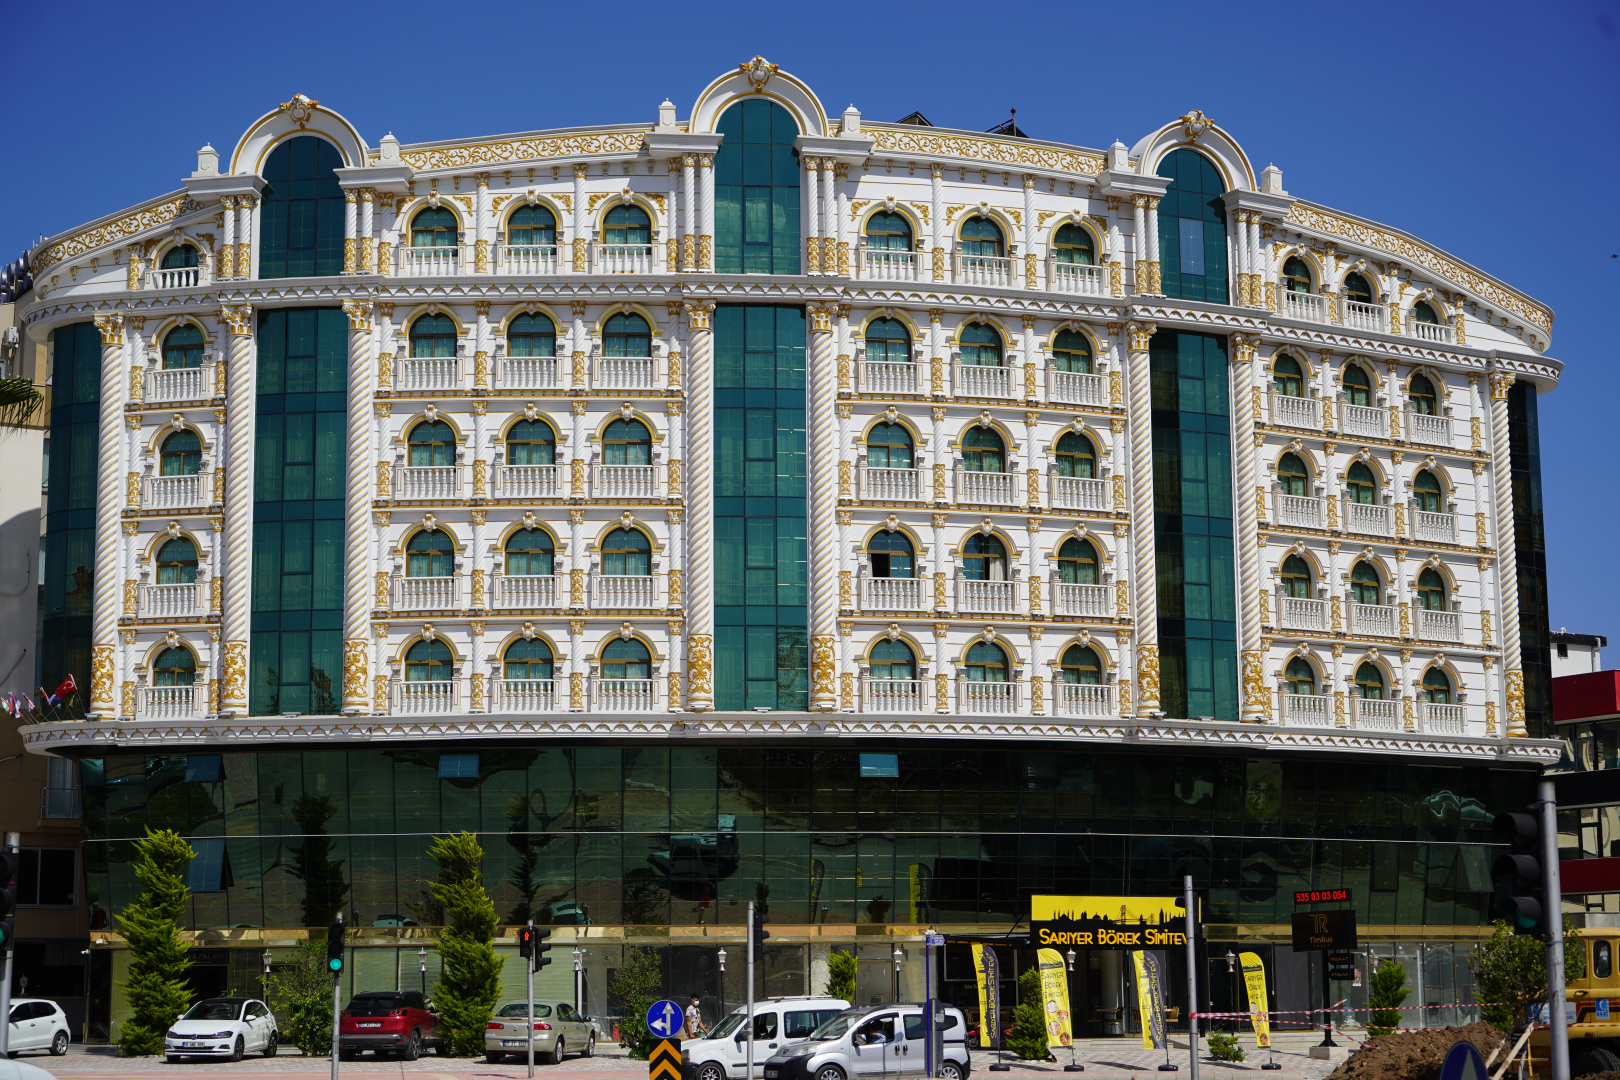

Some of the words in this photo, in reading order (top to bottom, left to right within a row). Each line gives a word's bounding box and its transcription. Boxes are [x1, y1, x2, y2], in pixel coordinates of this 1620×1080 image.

[1296, 893, 1309, 902] 535
[1311, 892, 1320, 901] 03
[1322, 891, 1331, 900] 03
[1332, 890, 1346, 900] 054
[1038, 927, 1093, 945] SARIYER
[1097, 928, 1141, 945] BÖREK
